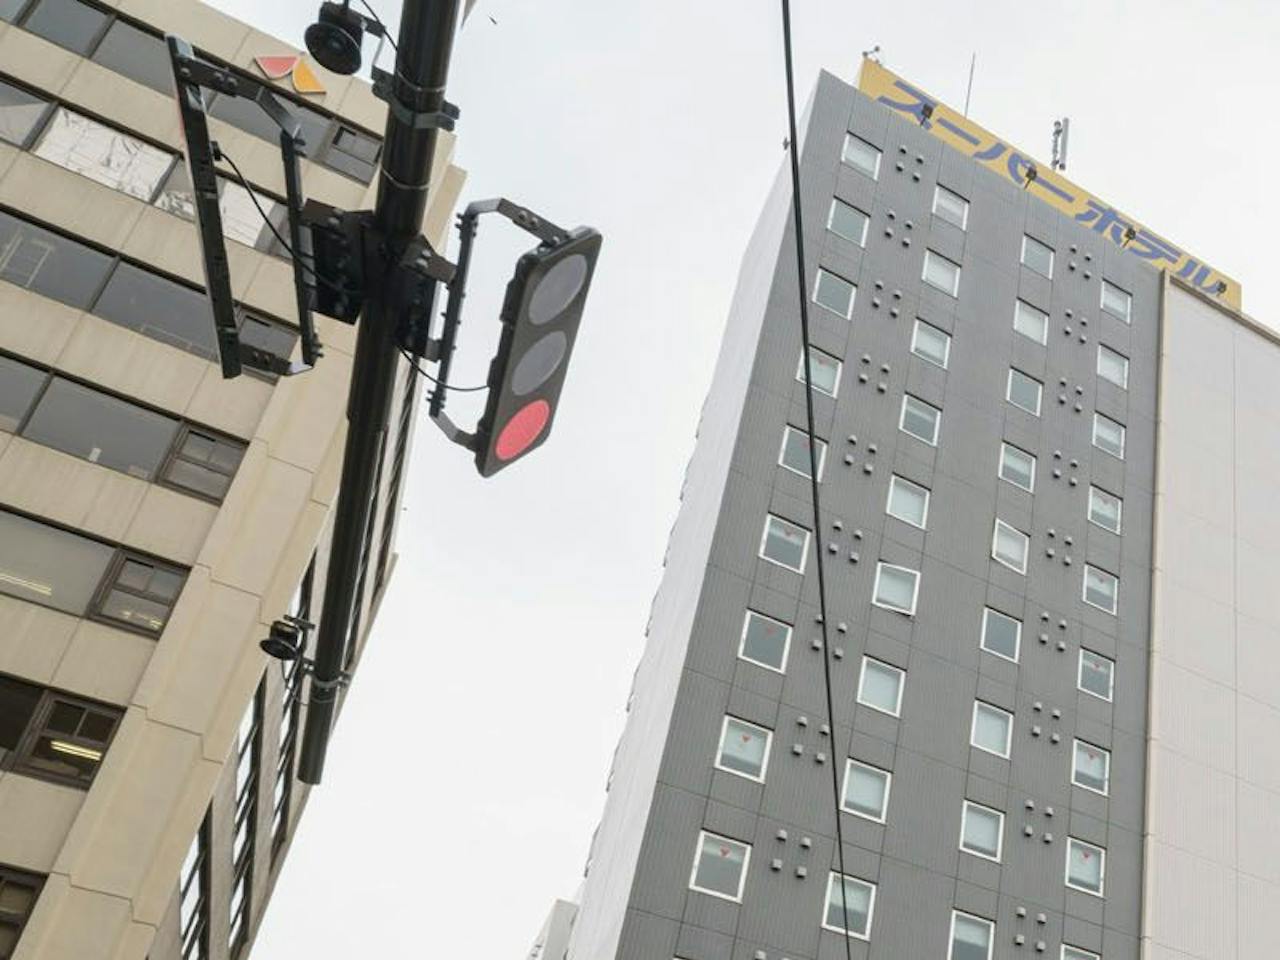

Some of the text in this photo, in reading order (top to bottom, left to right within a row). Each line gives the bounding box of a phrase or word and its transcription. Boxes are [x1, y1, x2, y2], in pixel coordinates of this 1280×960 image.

[876, 79, 1228, 296] スーパーホテル
